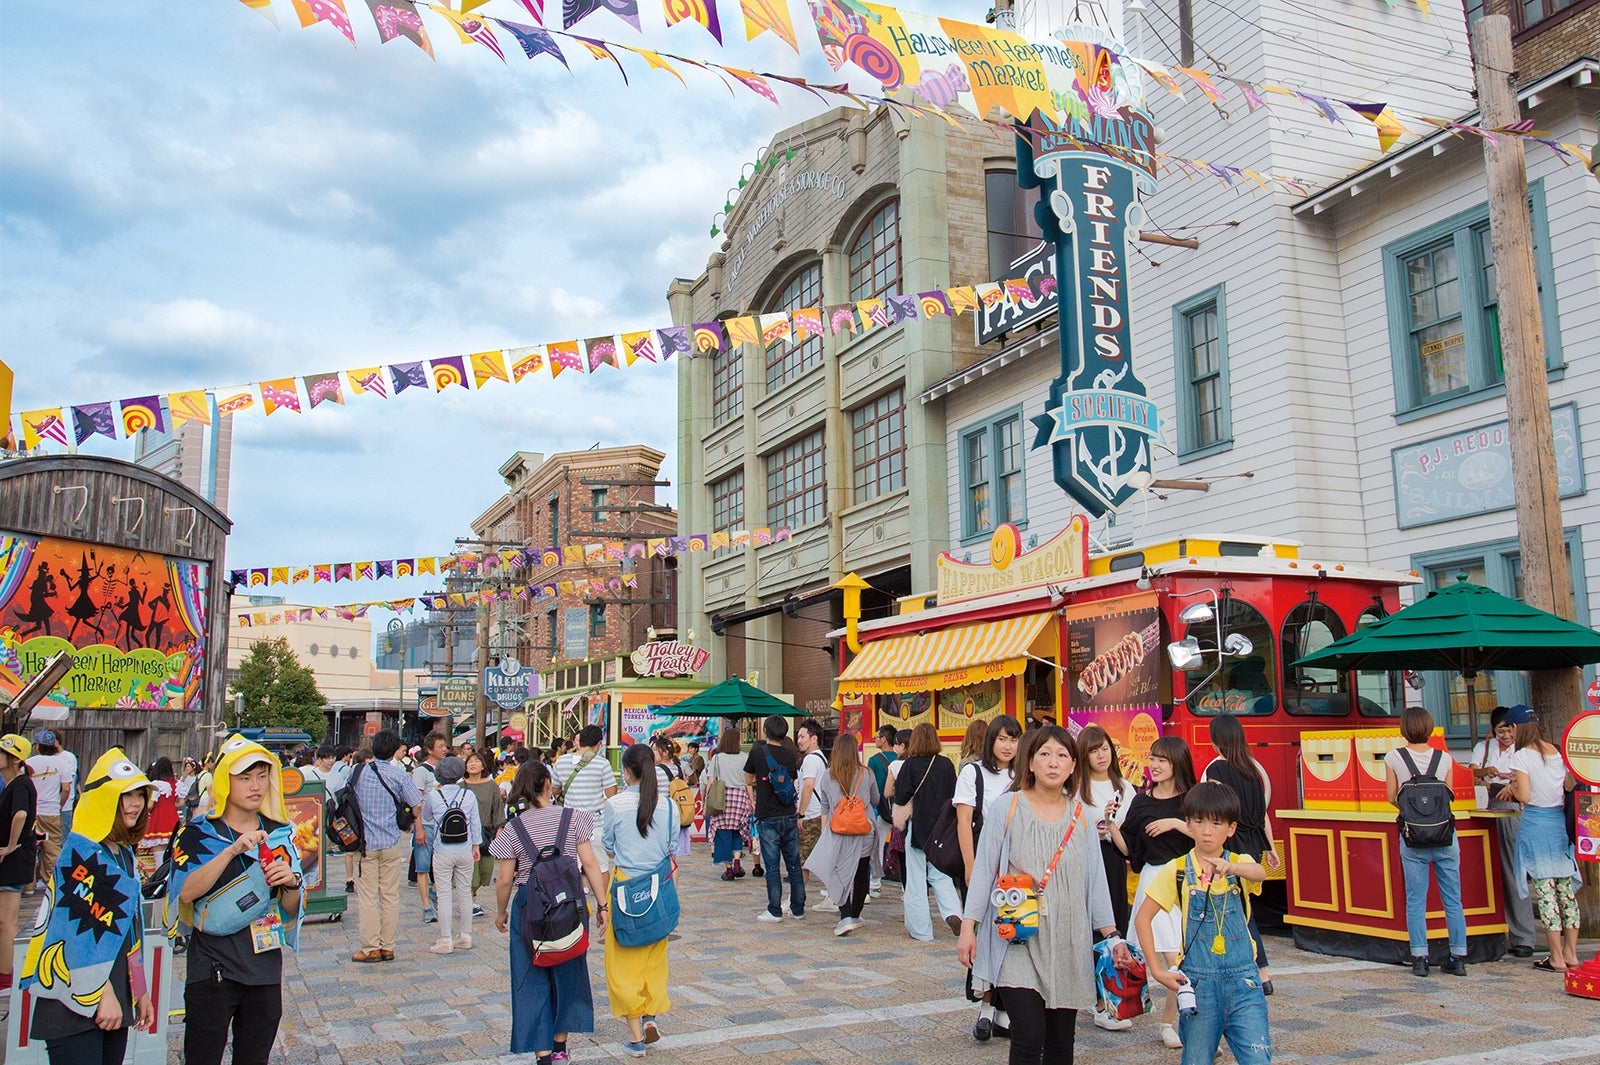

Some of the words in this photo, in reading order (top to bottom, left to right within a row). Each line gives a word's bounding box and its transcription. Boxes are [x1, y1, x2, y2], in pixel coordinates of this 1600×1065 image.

[887, 25, 997, 58] Halloween
[994, 39, 1087, 76] Happiness
[968, 59, 1046, 92] Market
[746, 183, 790, 245] WAREHOUSE
[795, 170, 831, 192] STORAGE
[1082, 164, 1122, 358] FRIENDS
[1071, 394, 1150, 427] SOCIETY
[1453, 426, 1512, 456] REDD
[942, 566, 1015, 599] HAPPINESS
[1019, 535, 1076, 583] WAGON
[645, 641, 694, 661] Trolley
[101, 653, 164, 678] Happiness
[646, 656, 691, 676] Treats
[943, 670, 968, 683] DRINKS
[984, 661, 1005, 675] COKE
[71, 673, 123, 693] Market
[441, 691, 475, 701] LOANS
[496, 693, 523, 701] DRUGS
[624, 725, 644, 733] ¥950
[1568, 742, 1600, 753] HAPP
